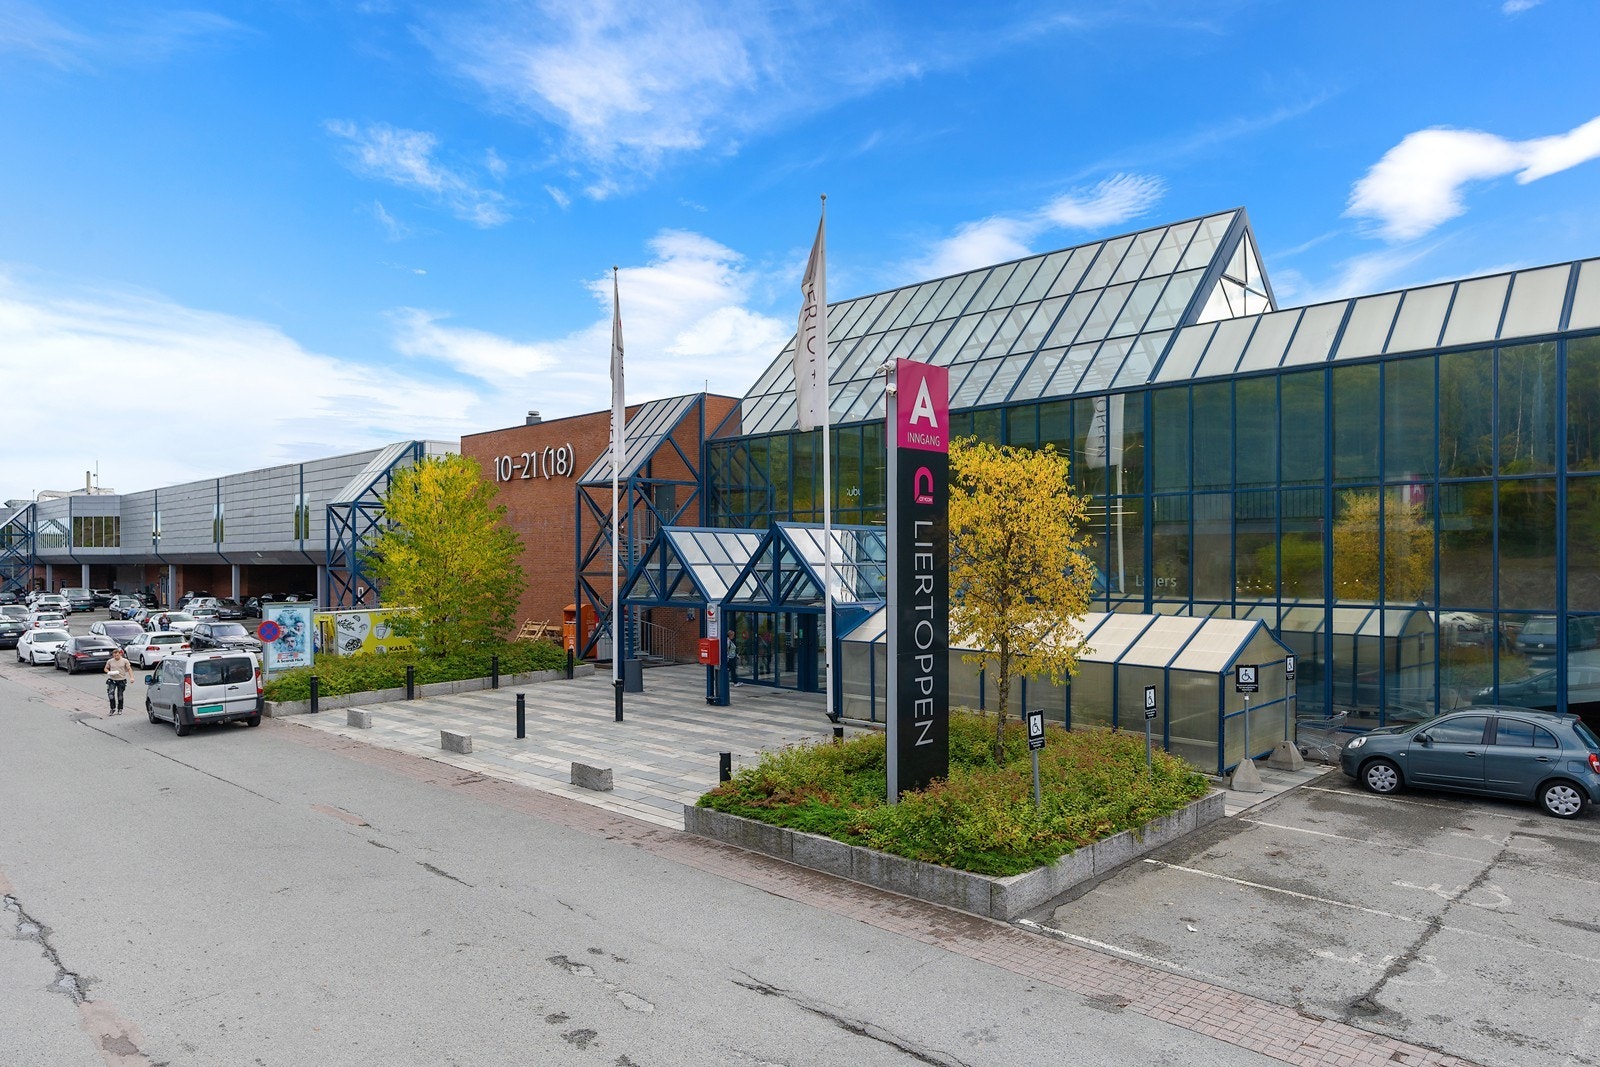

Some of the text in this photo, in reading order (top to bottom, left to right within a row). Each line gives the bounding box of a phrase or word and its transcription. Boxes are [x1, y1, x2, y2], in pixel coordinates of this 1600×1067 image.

[909, 375, 938, 428] A
[494, 442, 575, 482] 10-21 (18)
[907, 432, 940, 447] INNGANG
[914, 520, 934, 746] LIERTOPPEN
